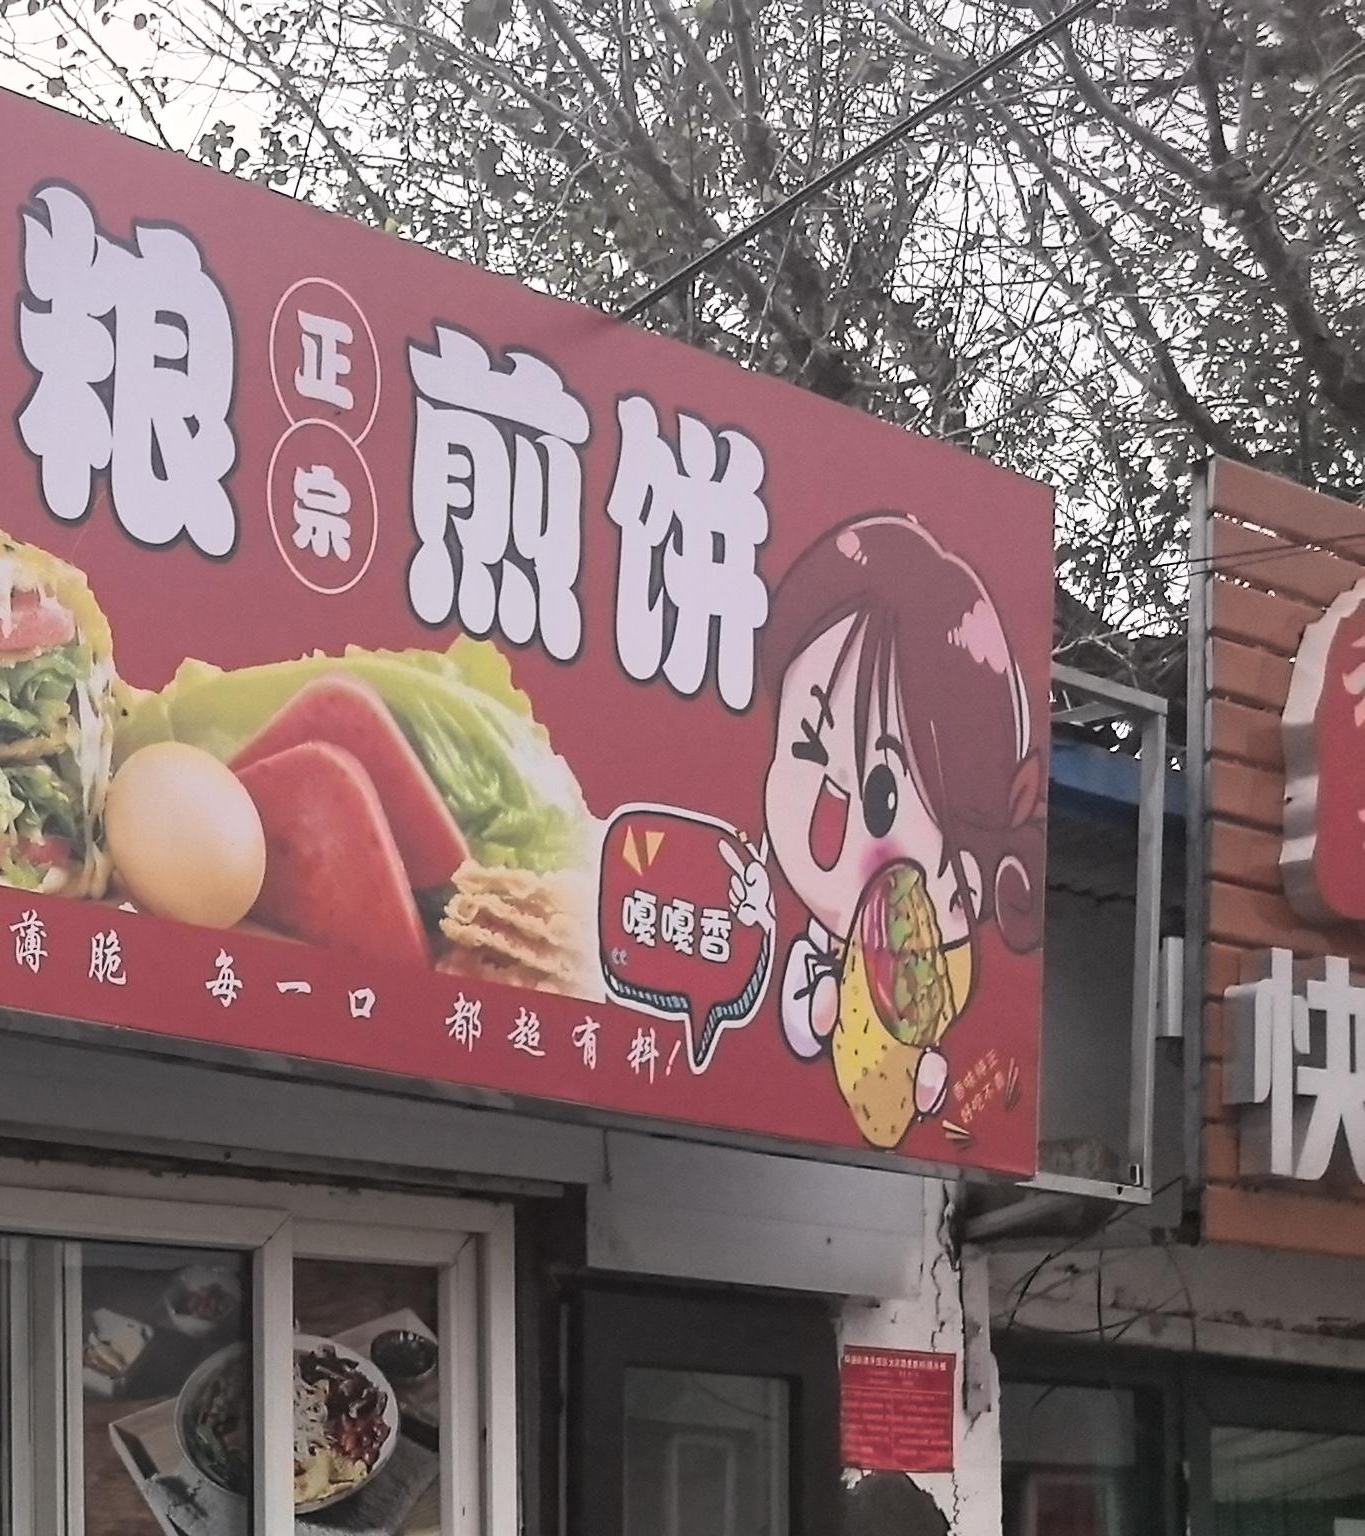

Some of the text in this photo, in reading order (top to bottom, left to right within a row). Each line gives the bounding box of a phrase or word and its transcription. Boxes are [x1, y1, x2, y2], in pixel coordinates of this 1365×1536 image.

[293, 305, 354, 562] 正宗
[404, 327, 770, 710] 煎饼
[205, 949, 376, 1018] 每一口
[623, 889, 732, 963] 嘎嘎香
